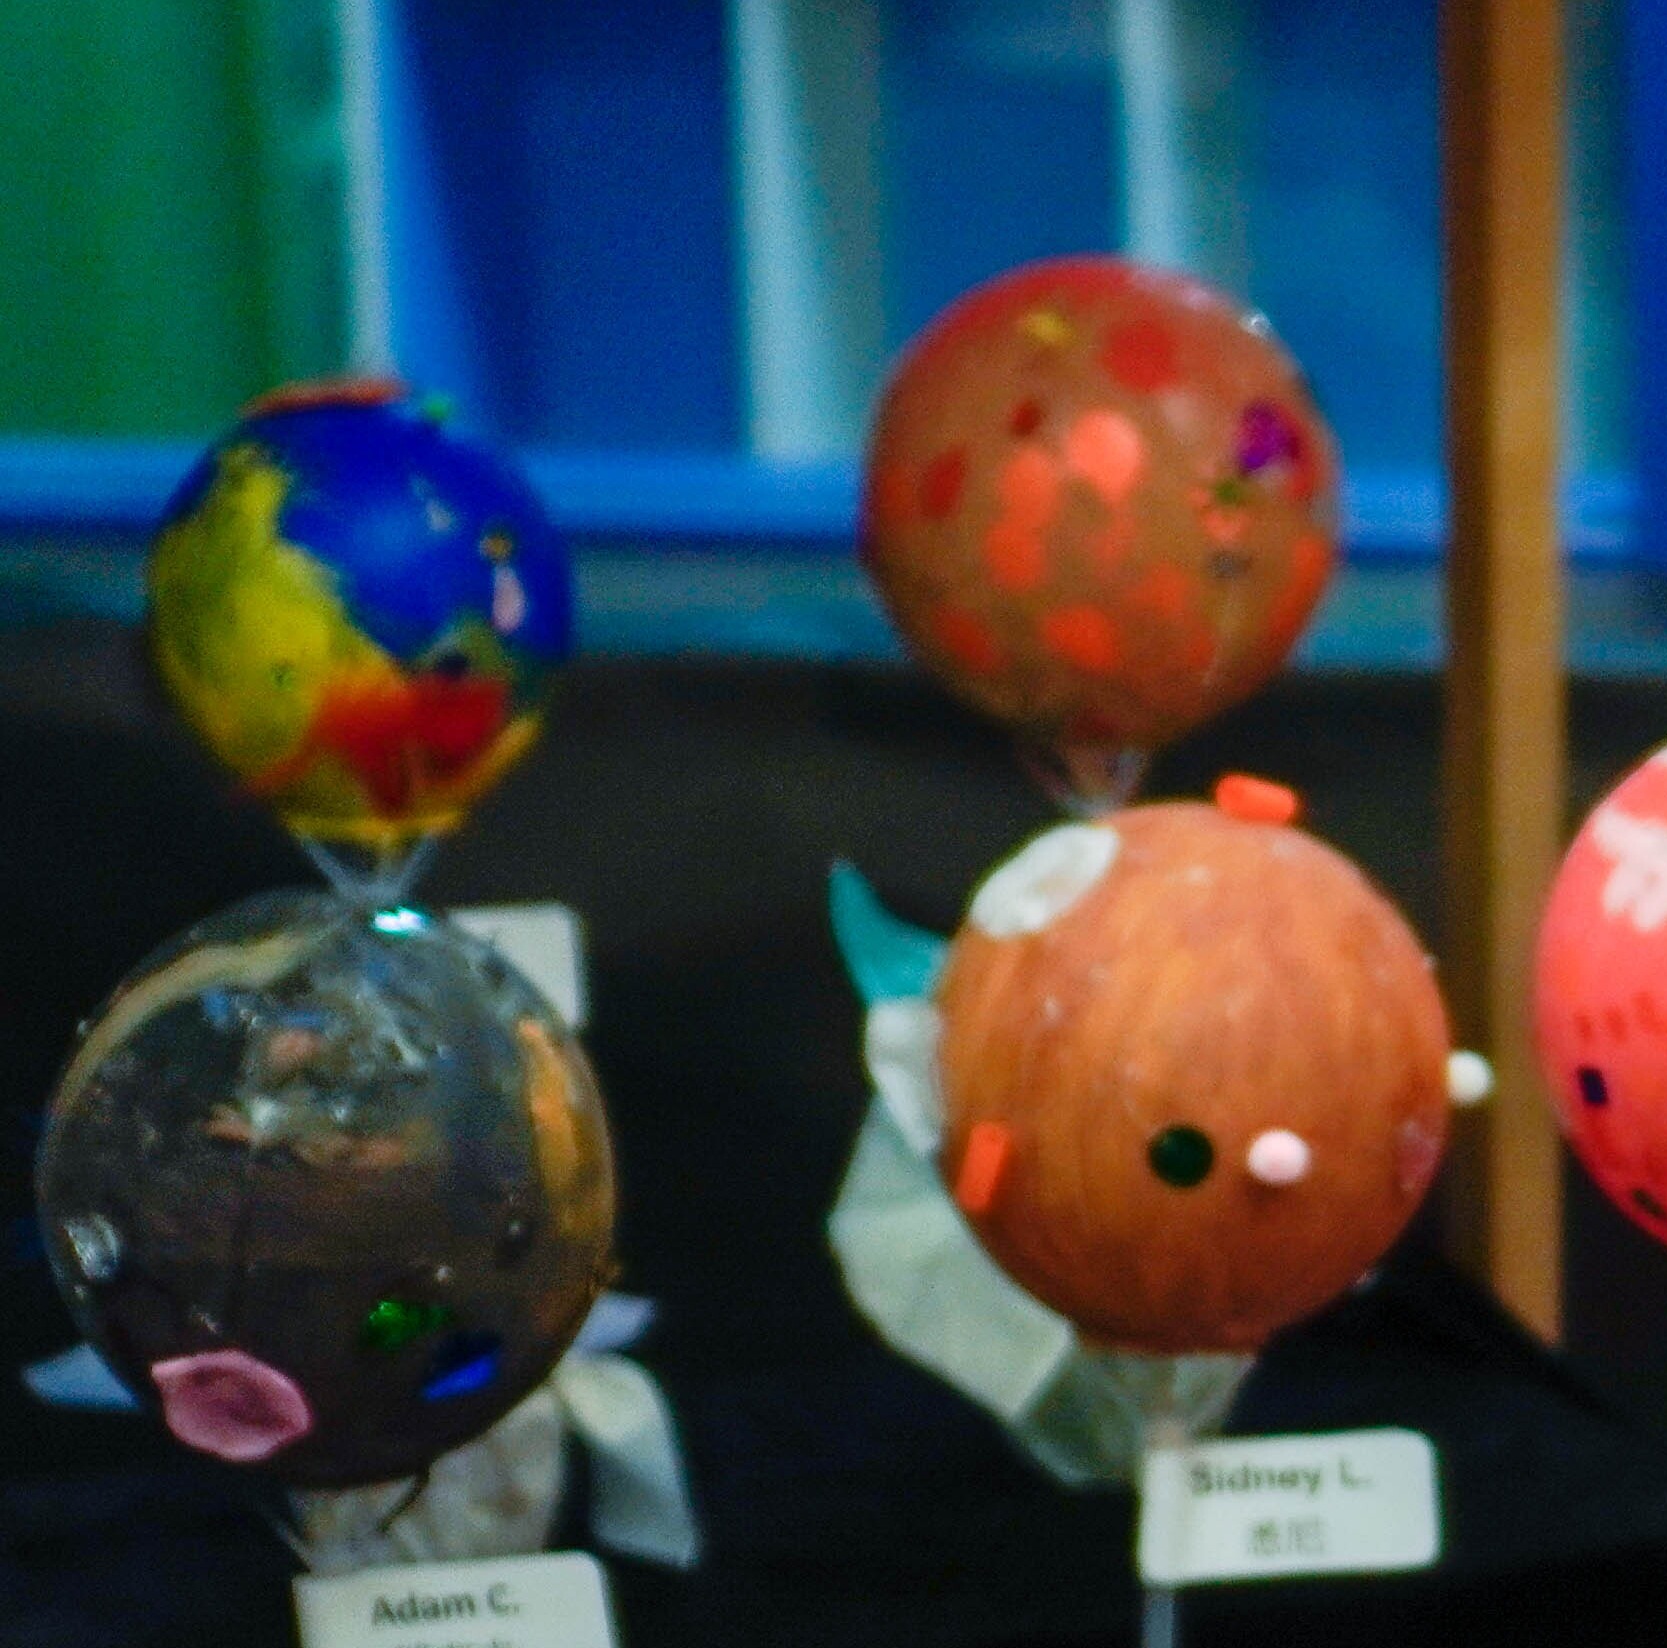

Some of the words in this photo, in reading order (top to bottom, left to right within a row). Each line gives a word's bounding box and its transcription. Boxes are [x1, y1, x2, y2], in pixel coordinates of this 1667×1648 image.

[1192, 1460, 1320, 1497] Sidney
[373, 1590, 475, 1627] Adam
[488, 1582, 521, 1614] C.
